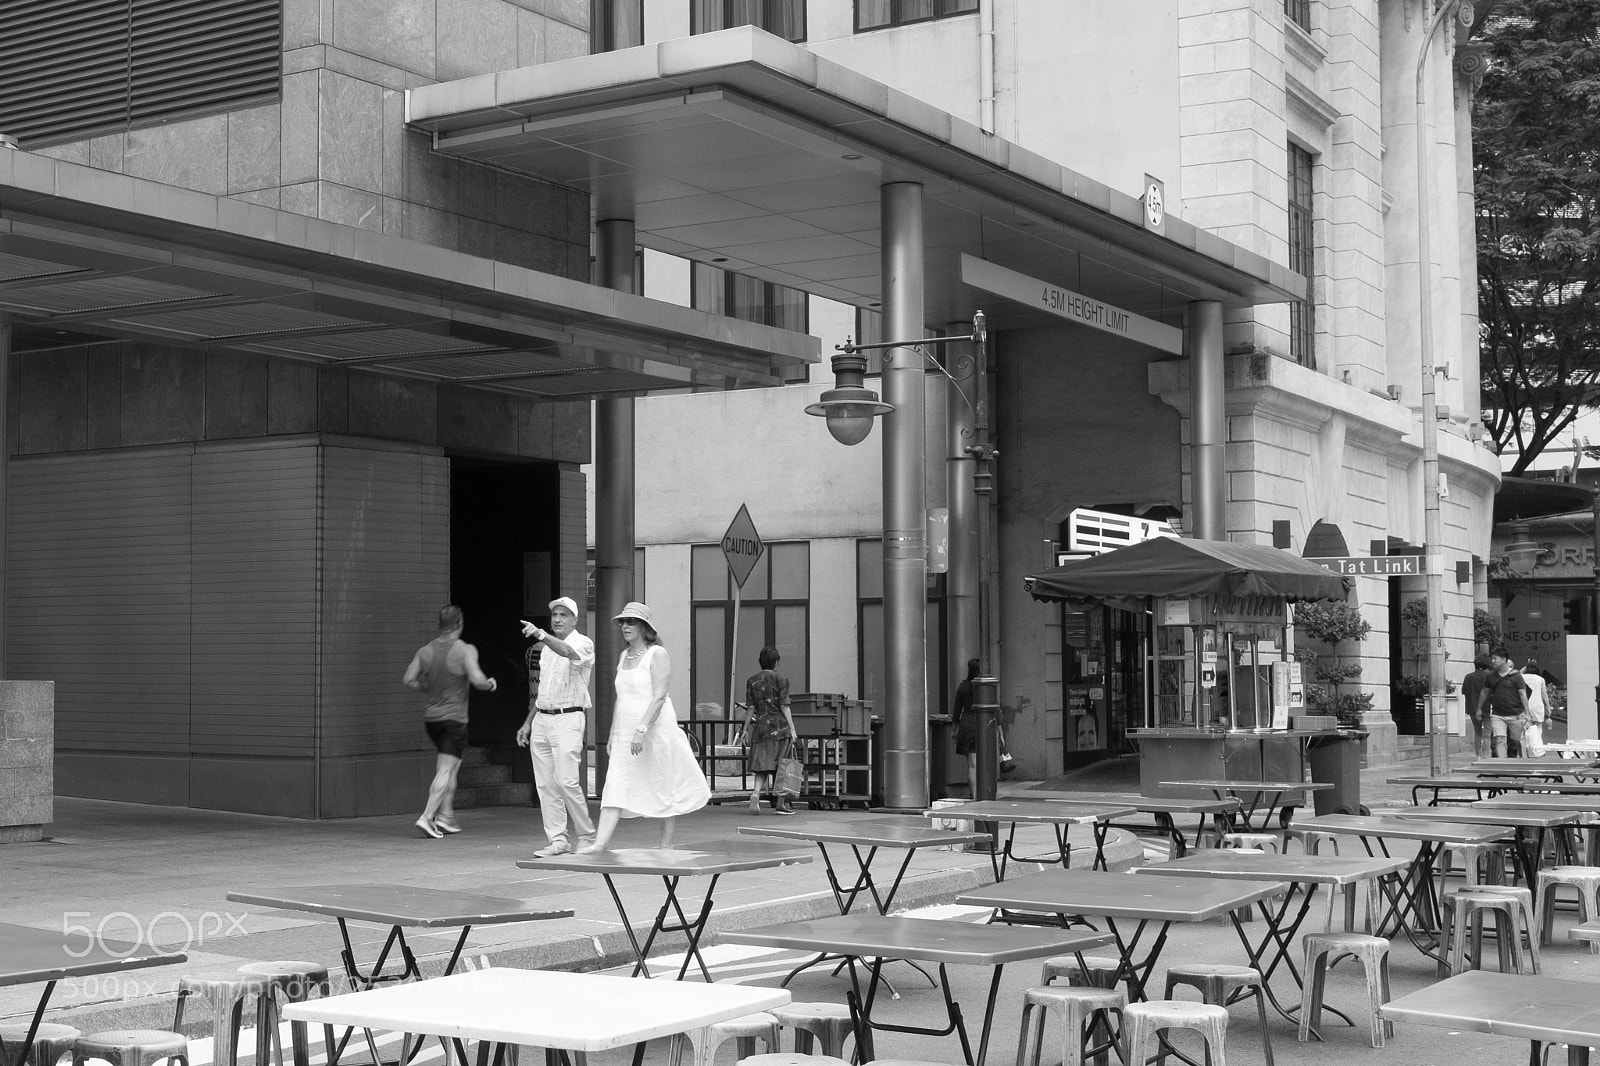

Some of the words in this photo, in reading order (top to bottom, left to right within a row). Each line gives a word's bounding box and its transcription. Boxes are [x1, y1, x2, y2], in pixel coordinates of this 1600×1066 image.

[1147, 193, 1161, 213] 4.5m
[1041, 287, 1065, 311] 4.5M
[1067, 295, 1104, 325] HEIGHT
[1106, 309, 1130, 333] LIMIT
[725, 537, 759, 556] CAUTION
[1337, 559, 1366, 574] Tat
[1373, 558, 1412, 573] Link
